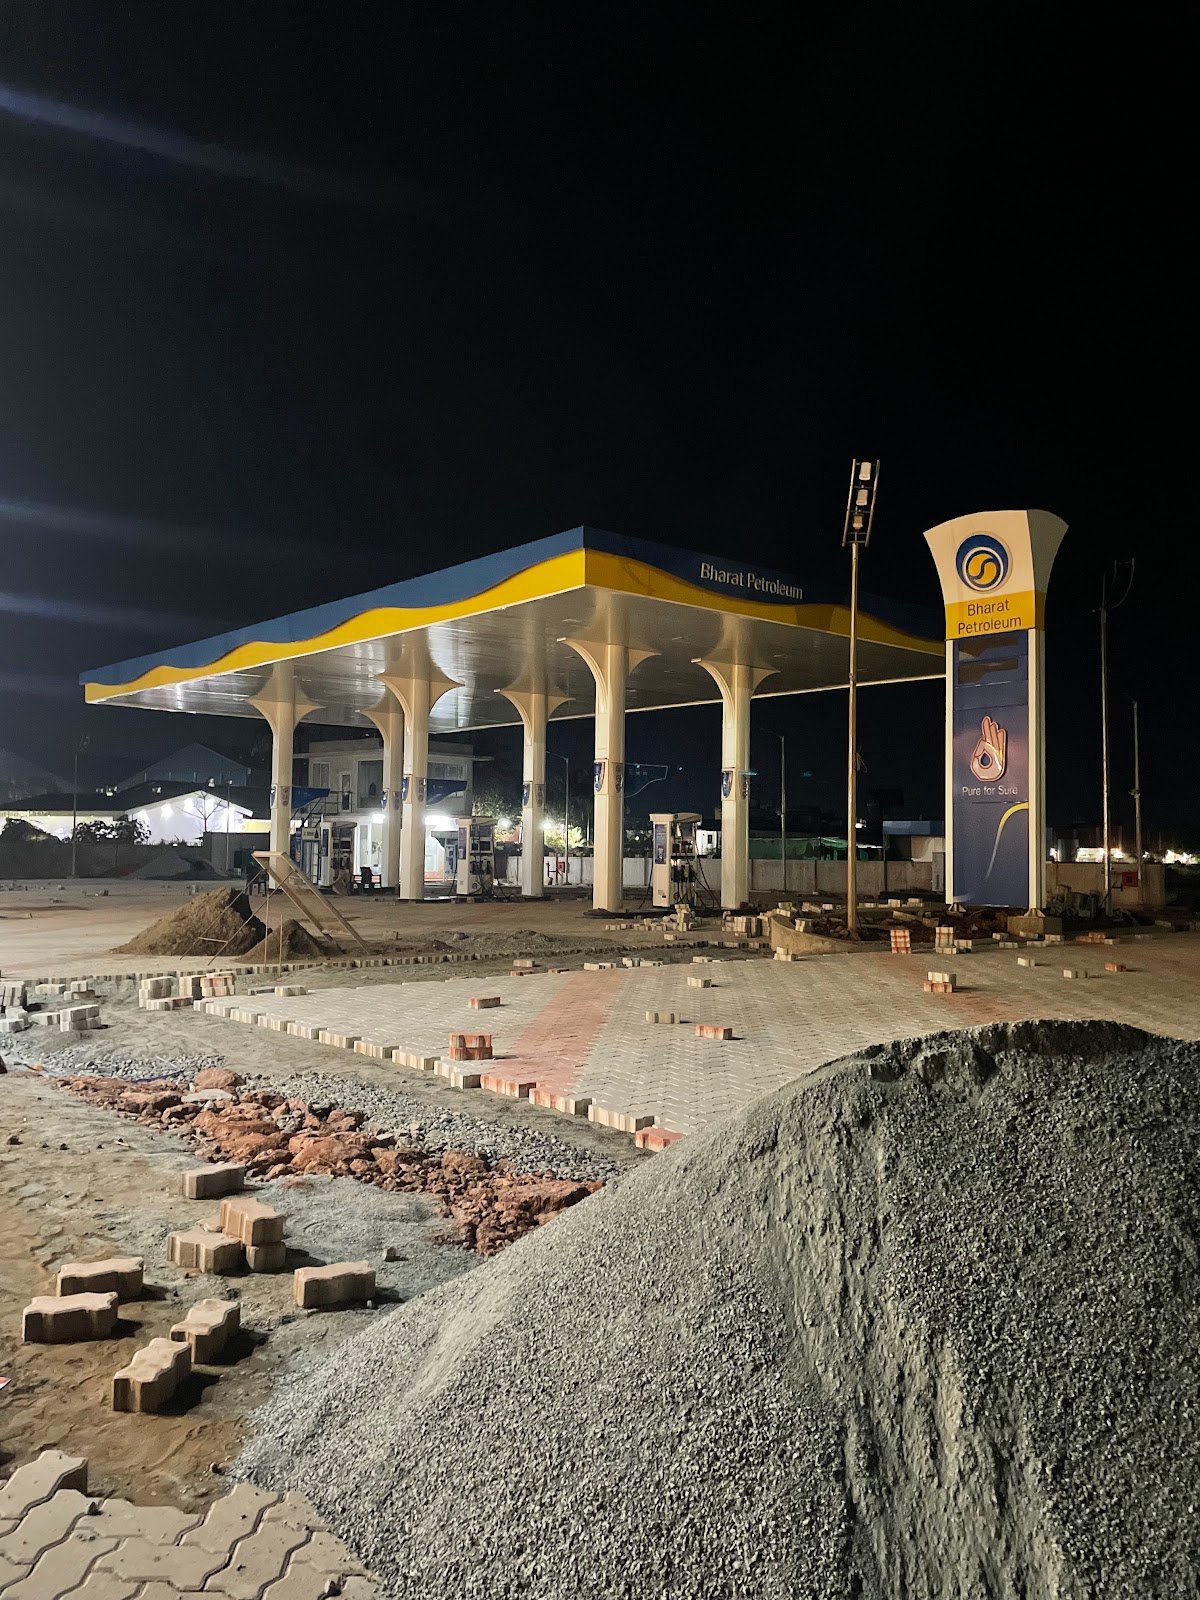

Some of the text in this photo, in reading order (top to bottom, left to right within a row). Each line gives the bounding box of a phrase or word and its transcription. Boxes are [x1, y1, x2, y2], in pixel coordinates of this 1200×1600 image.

[701, 562, 803, 599] Bharat Petroleum
[967, 599, 1010, 616] Bharat
[958, 617, 1021, 635] Petroleum
[962, 785, 1019, 796] Pure for Sure
